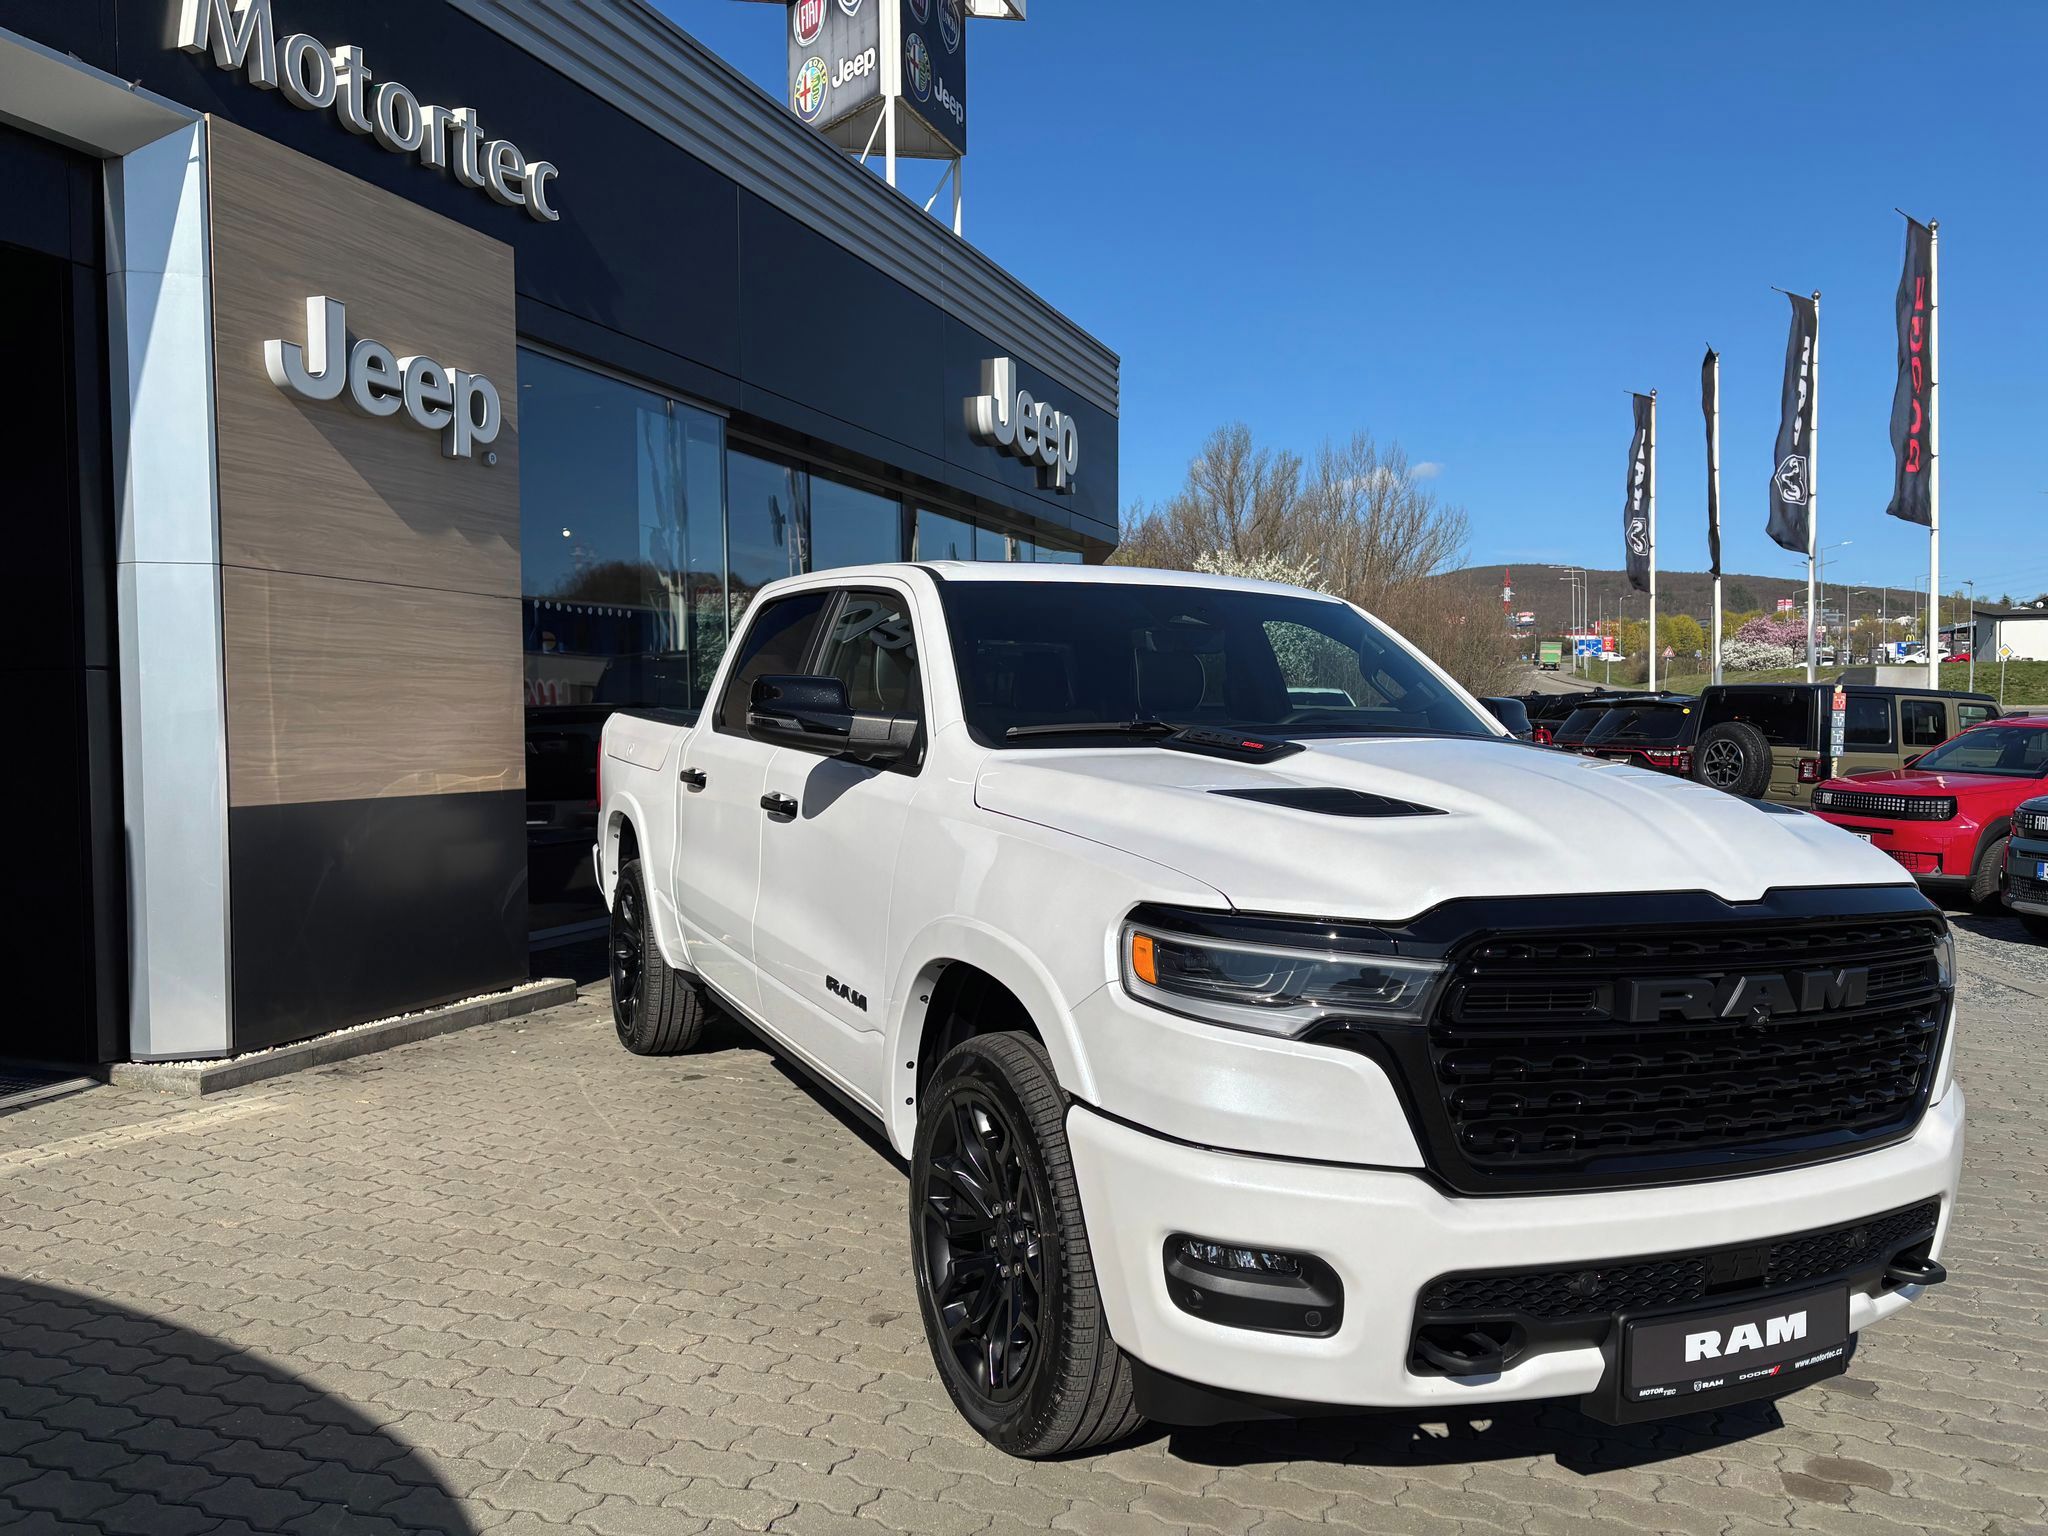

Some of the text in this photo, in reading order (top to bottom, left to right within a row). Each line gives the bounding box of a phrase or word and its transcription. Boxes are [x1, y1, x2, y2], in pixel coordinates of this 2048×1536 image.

[832, 47, 876, 88] Jeep
[177, 0, 560, 222] Motortec
[934, 77, 964, 125] Jeep
[264, 296, 501, 458] Jeep
[975, 357, 1079, 488] Jeep
[825, 974, 867, 1012] RAM
[1618, 966, 1870, 1024] RAM
[1684, 1310, 1807, 1362] RAM
[1794, 1347, 1843, 1368] www.motortec.cz
[1702, 1379, 1724, 1389] RAM
[1739, 1368, 1775, 1380] DODGE
